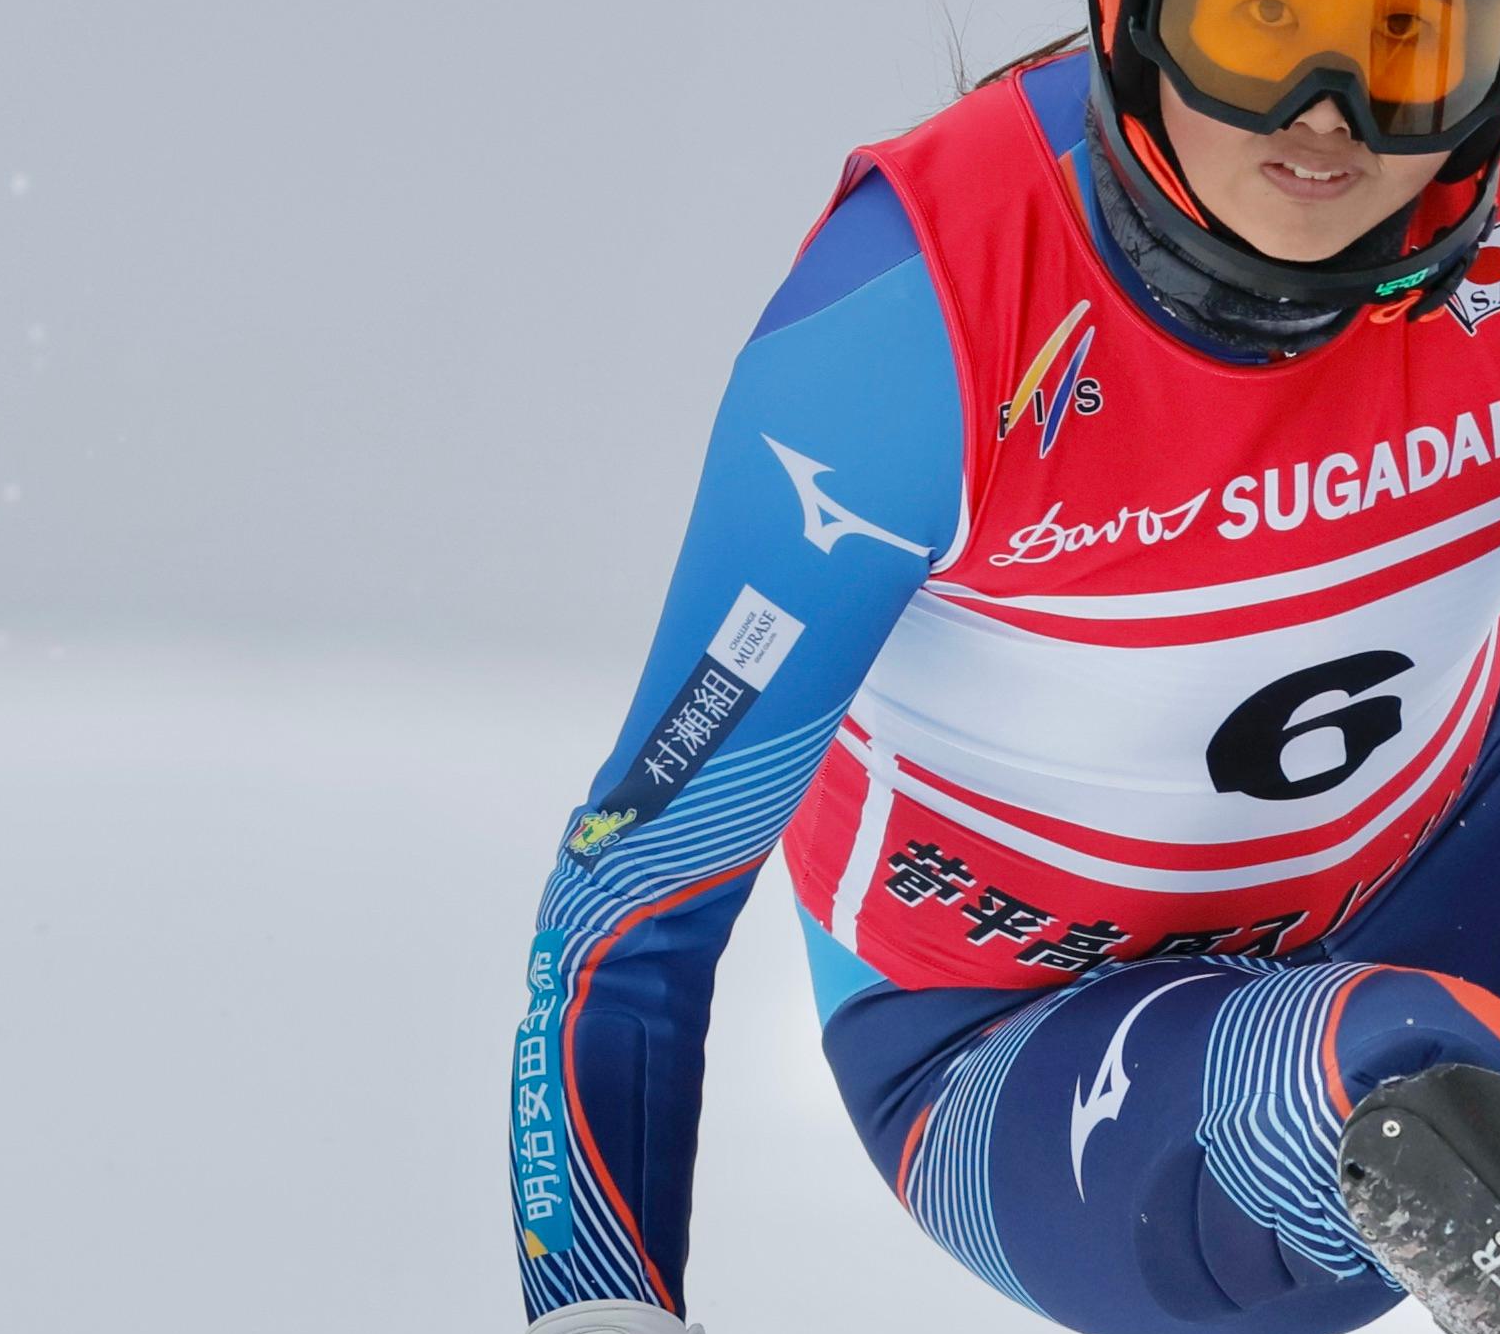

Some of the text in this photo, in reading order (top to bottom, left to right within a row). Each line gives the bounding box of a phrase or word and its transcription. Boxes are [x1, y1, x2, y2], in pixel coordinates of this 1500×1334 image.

[733, 609, 777, 669] MURASE
[644, 668, 744, 785] 村瀬組
[1206, 650, 1414, 800] 6
[517, 950, 563, 1222] 明治安田生命
